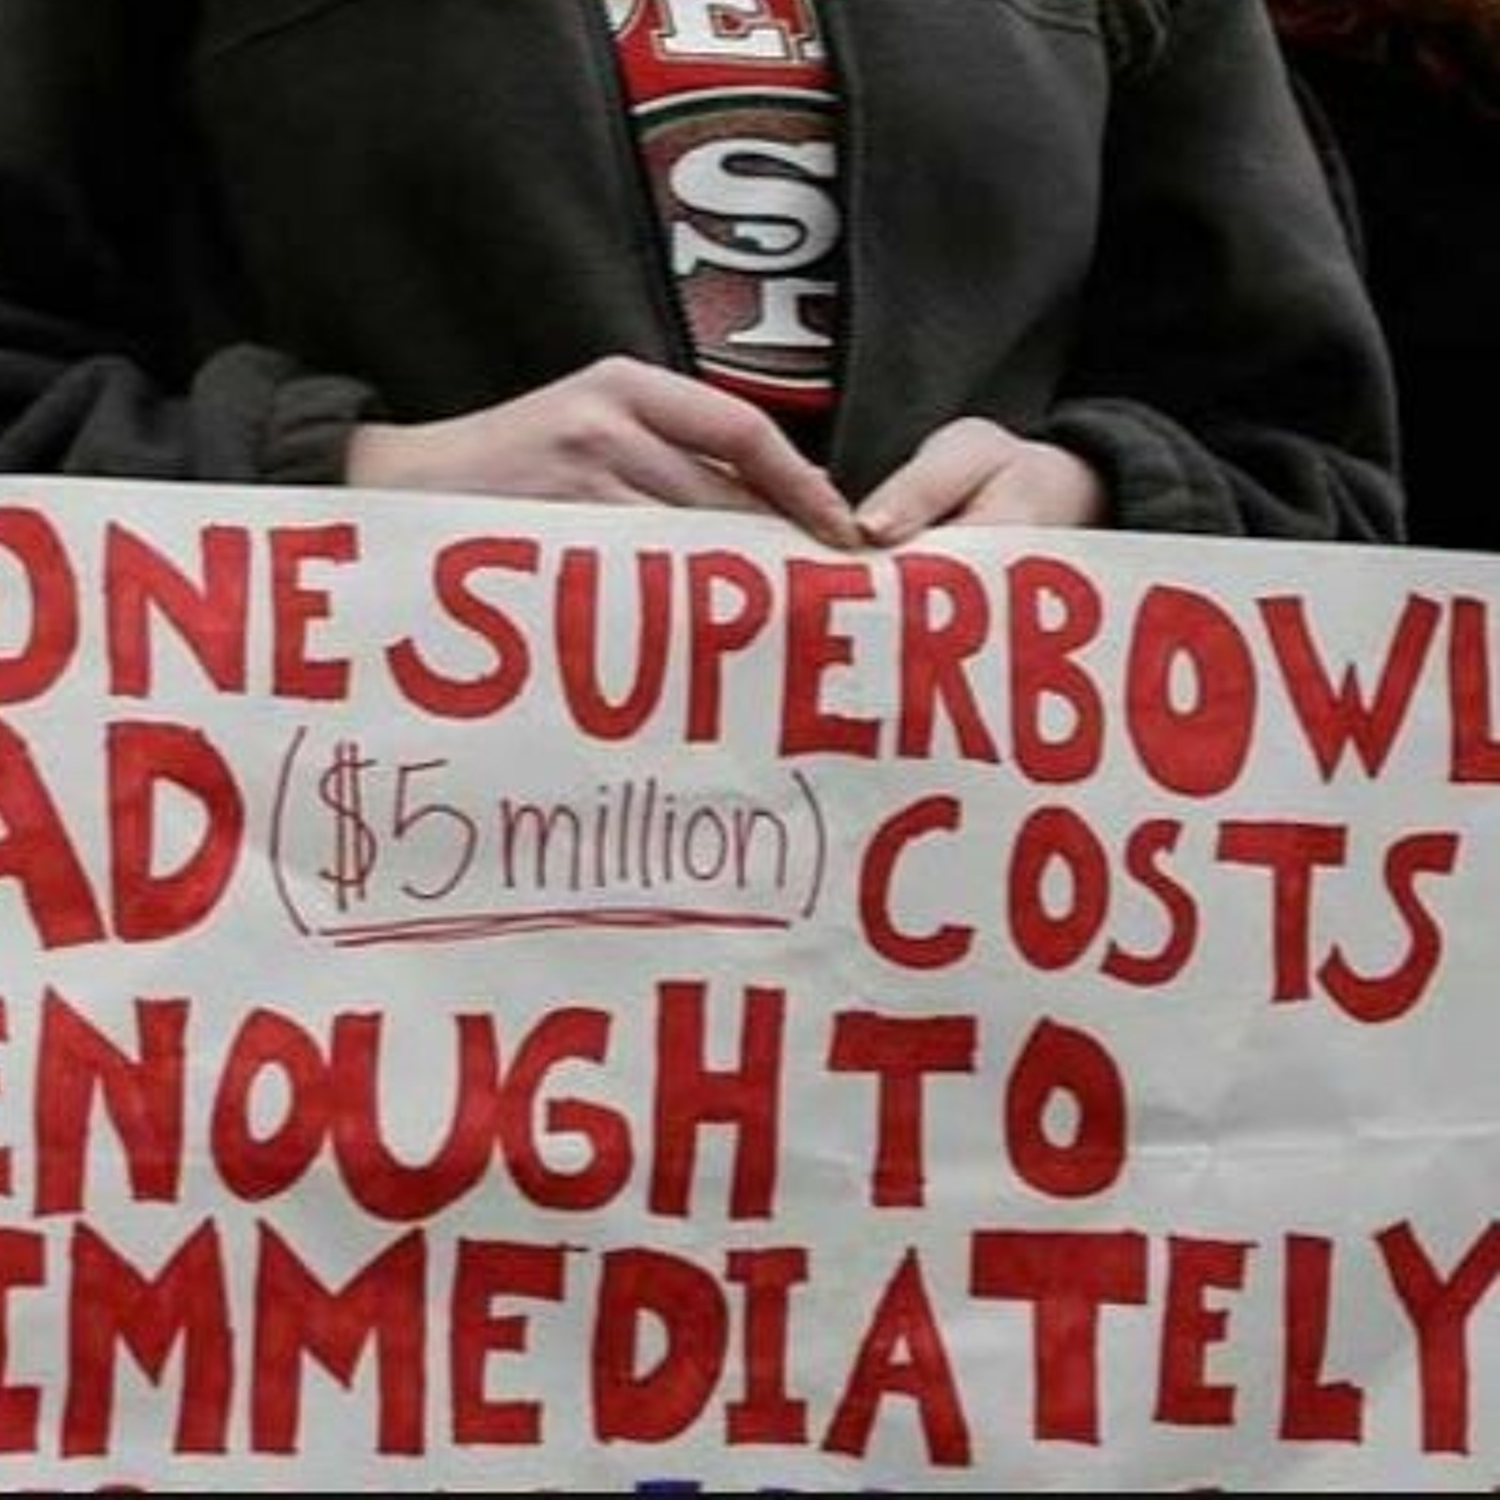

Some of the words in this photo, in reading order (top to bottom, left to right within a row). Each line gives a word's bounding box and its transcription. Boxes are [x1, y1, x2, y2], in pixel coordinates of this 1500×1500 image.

[386, 534, 1500, 801] SUPERBOWL
[269, 724, 479, 938] ($5
[500, 770, 828, 920] million)
[858, 794, 1460, 1023] COSTS
[827, 1010, 1129, 1209] TO
